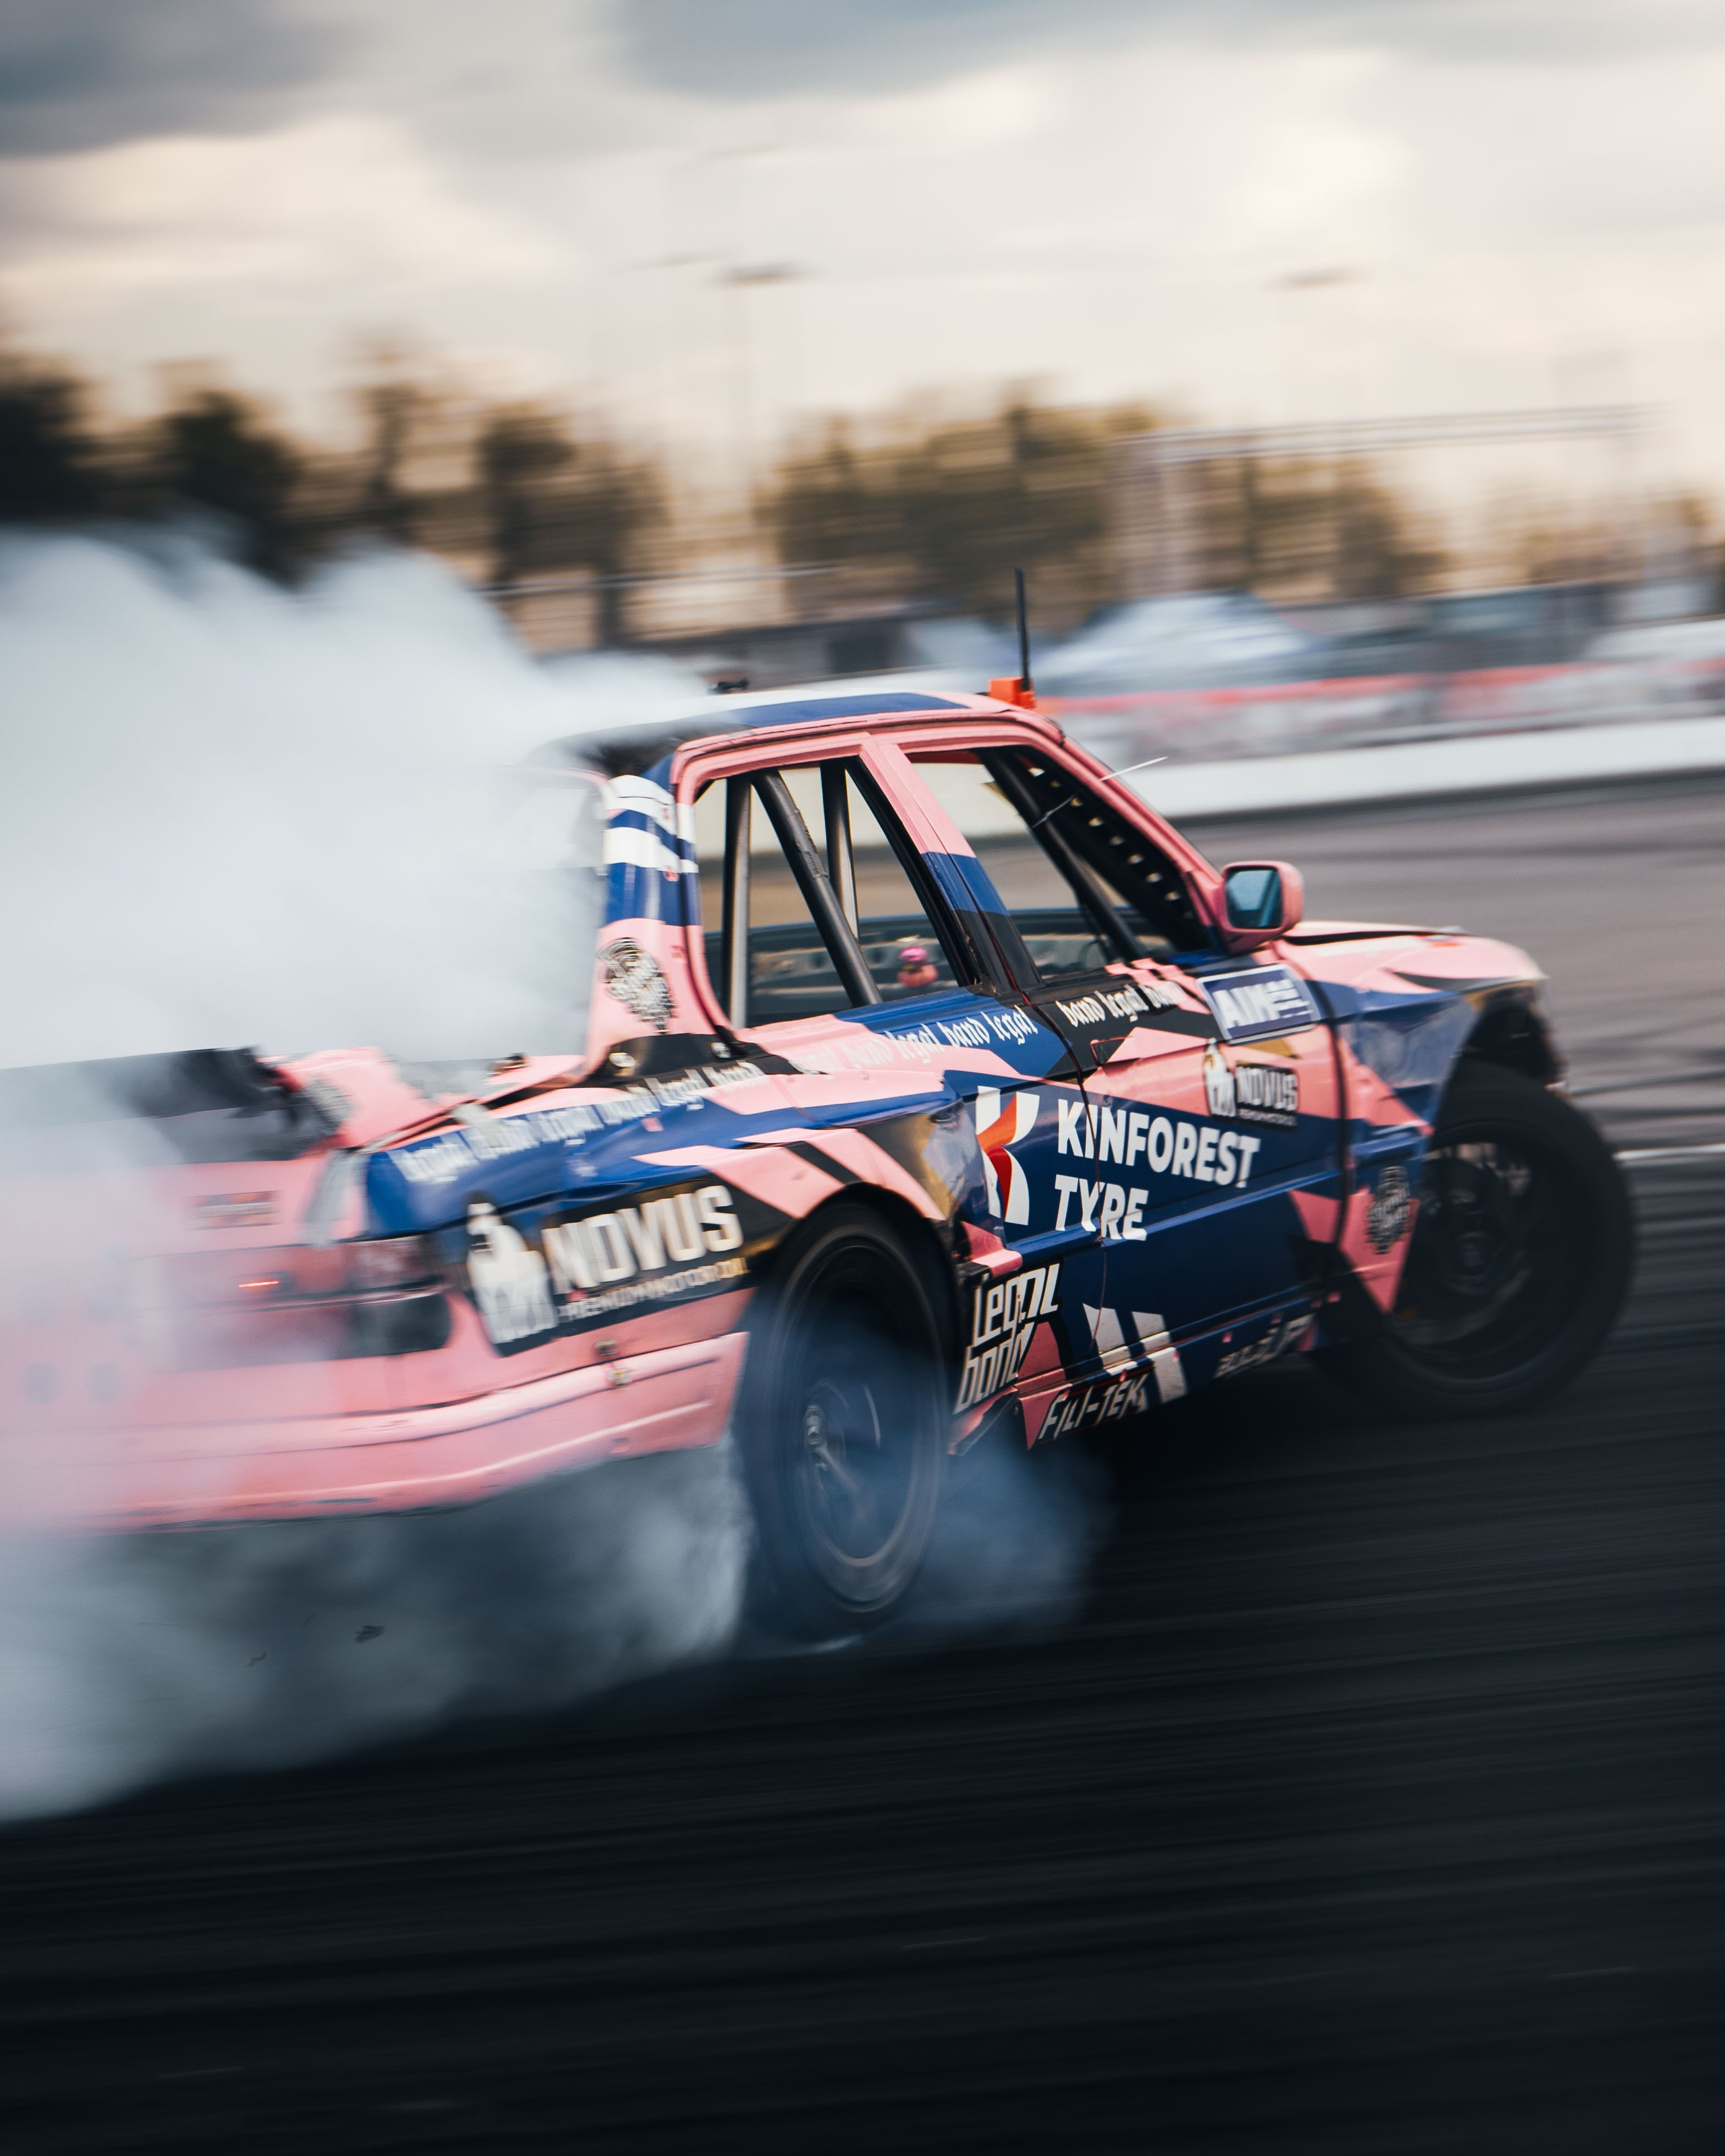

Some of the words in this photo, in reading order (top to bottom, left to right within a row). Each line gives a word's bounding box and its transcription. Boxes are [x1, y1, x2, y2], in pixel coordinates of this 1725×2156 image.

[980, 1005, 1038, 1045] legal
[1236, 1066, 1298, 1111] NOVUS
[1057, 1098, 1261, 1188] KINFOREST
[541, 1185, 744, 1294] NOVUS
[1055, 1174, 1149, 1240] TYRE
